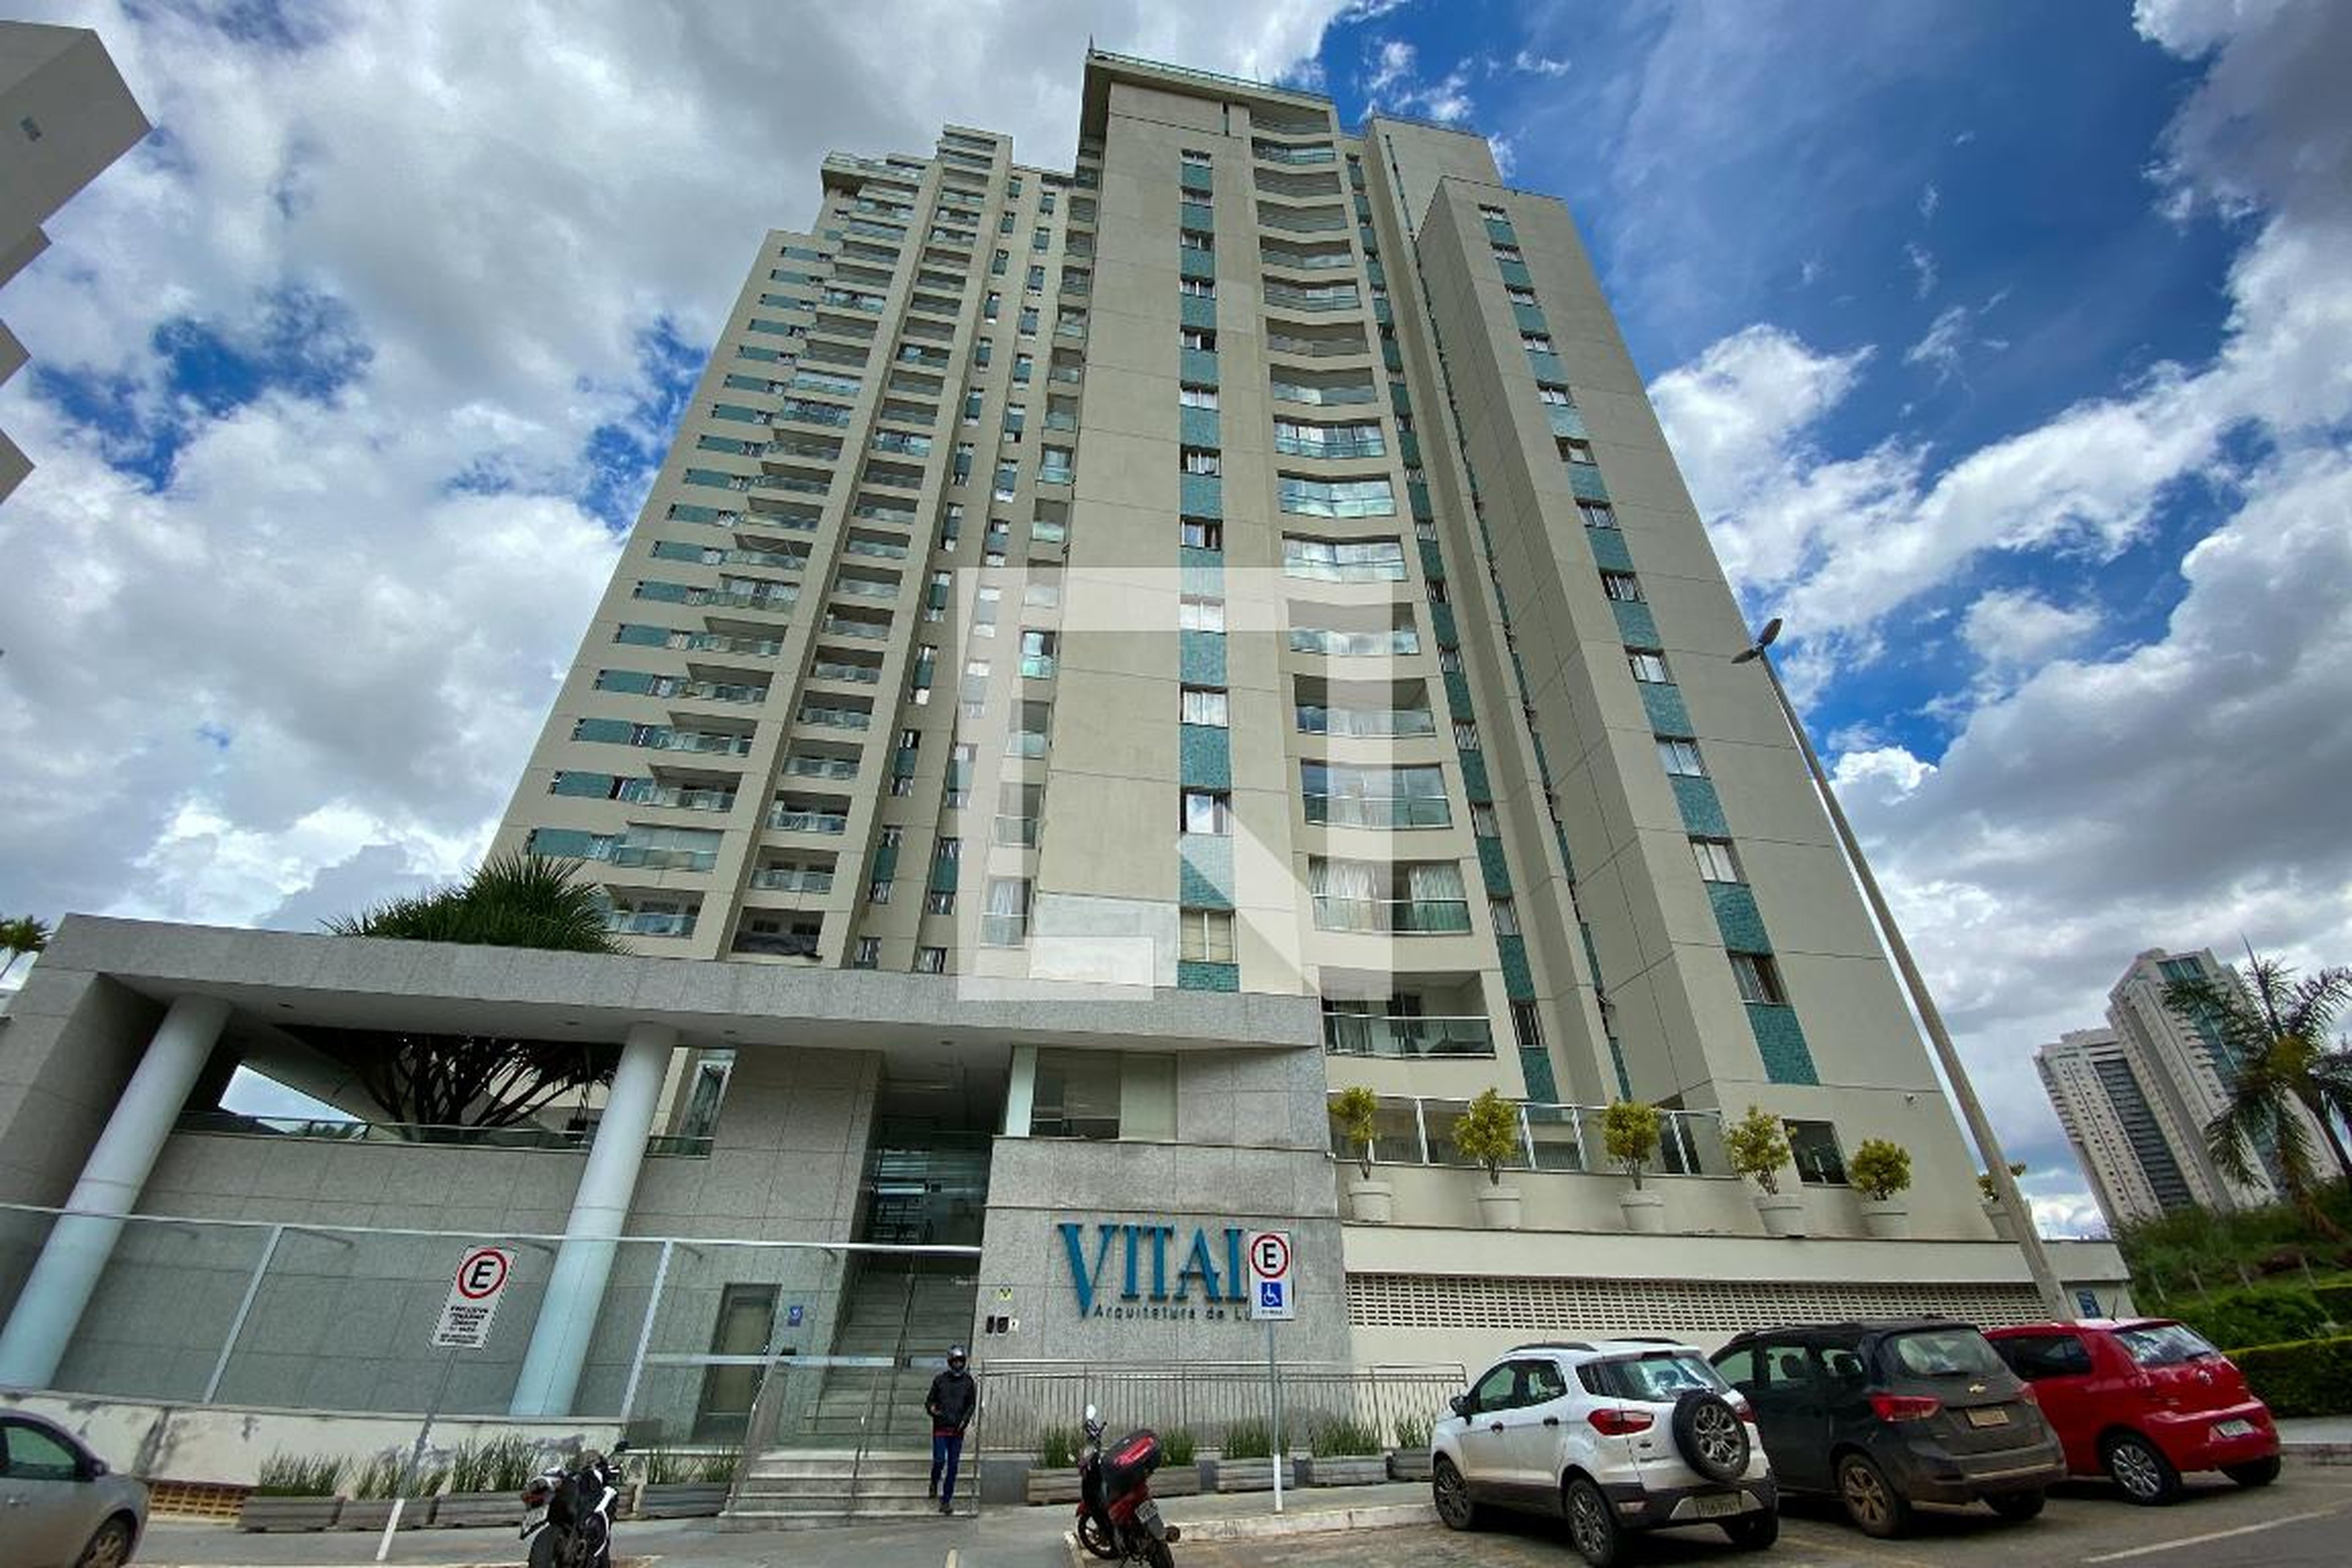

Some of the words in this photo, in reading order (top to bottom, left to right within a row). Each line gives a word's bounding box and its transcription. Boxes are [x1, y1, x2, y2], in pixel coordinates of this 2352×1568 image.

[1263, 1243, 1276, 1268] E
[469, 1261, 496, 1288] E
[1093, 1303, 1196, 1319] Arquitetura
[1205, 1306, 1224, 1319] de
